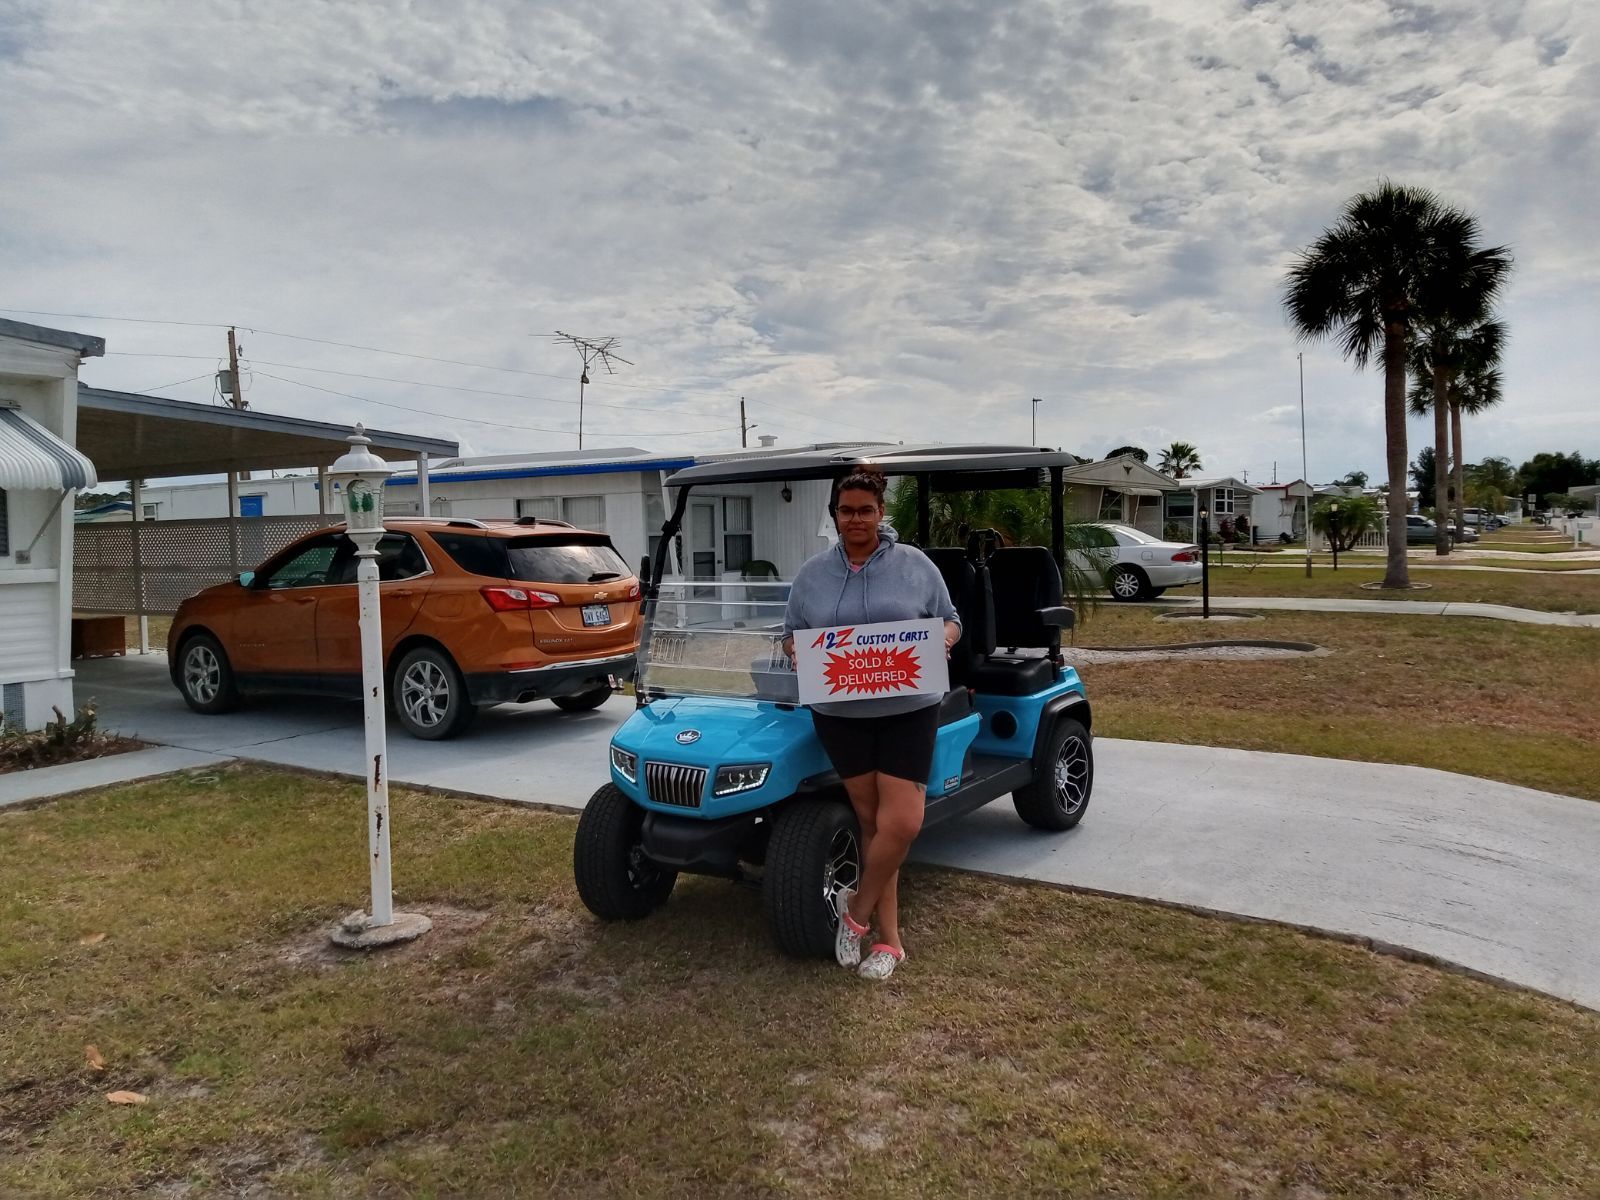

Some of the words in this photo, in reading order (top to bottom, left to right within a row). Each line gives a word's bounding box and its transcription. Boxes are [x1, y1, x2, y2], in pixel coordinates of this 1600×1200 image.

[811, 628, 855, 650] A2Z
[856, 633, 895, 646] CUSTOM
[899, 630, 929, 642] CARTS
[848, 657, 881, 669] SOLD
[885, 656, 895, 667] &
[838, 670, 907, 686] DELIVERED
